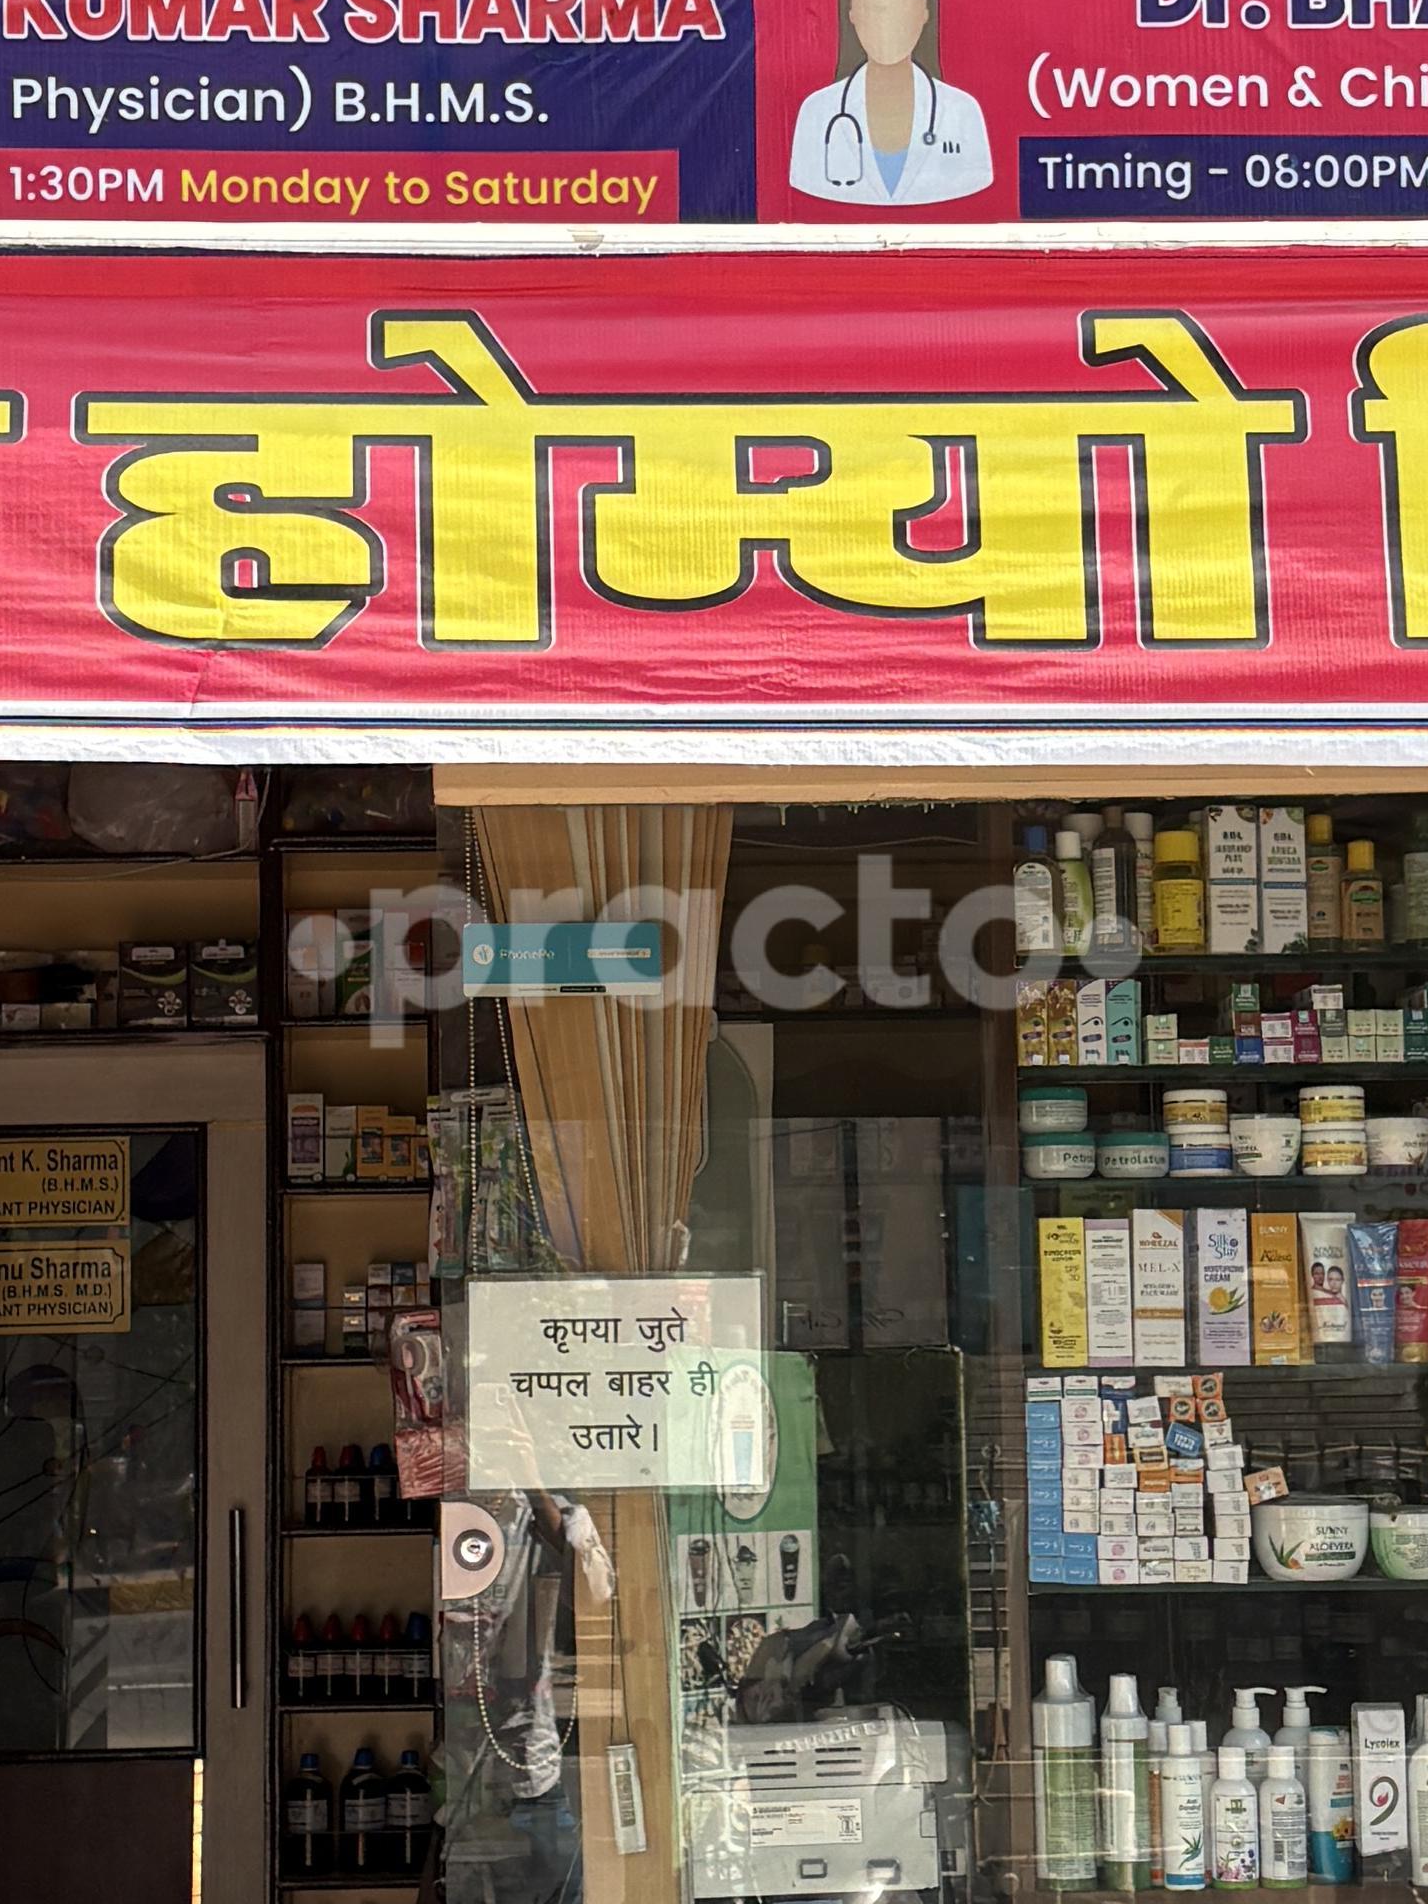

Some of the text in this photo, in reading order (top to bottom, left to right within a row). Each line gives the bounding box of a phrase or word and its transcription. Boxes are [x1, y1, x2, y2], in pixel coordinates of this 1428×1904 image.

[12, 63, 314, 133] Physician)
[334, 79, 550, 125] B.H.M.S.
[1027, 52, 1270, 121] (Women
[1288, 66, 1322, 109] &
[10, 166, 163, 203] 1:30PM
[180, 167, 371, 216] Monday
[385, 170, 427, 206] to
[444, 167, 659, 216] Saturday
[1038, 154, 1193, 200] Timing
[73, 306, 1310, 652] होम्यो
[22, 1149, 40, 1172] K.
[47, 1149, 119, 1172] Sharma
[42, 1177, 119, 1194] (B.H.M.S.)
[28, 1199, 116, 1216] PHYSICIAN
[30, 1257, 112, 1279] Sharma
[27, 1301, 114, 1318] PHYSICIAN)
[539, 1307, 689, 1354] कृपया जुते
[510, 1361, 719, 1398] चप्पल बाहर ही
[1315, 1526, 1349, 1535] SUNNY
